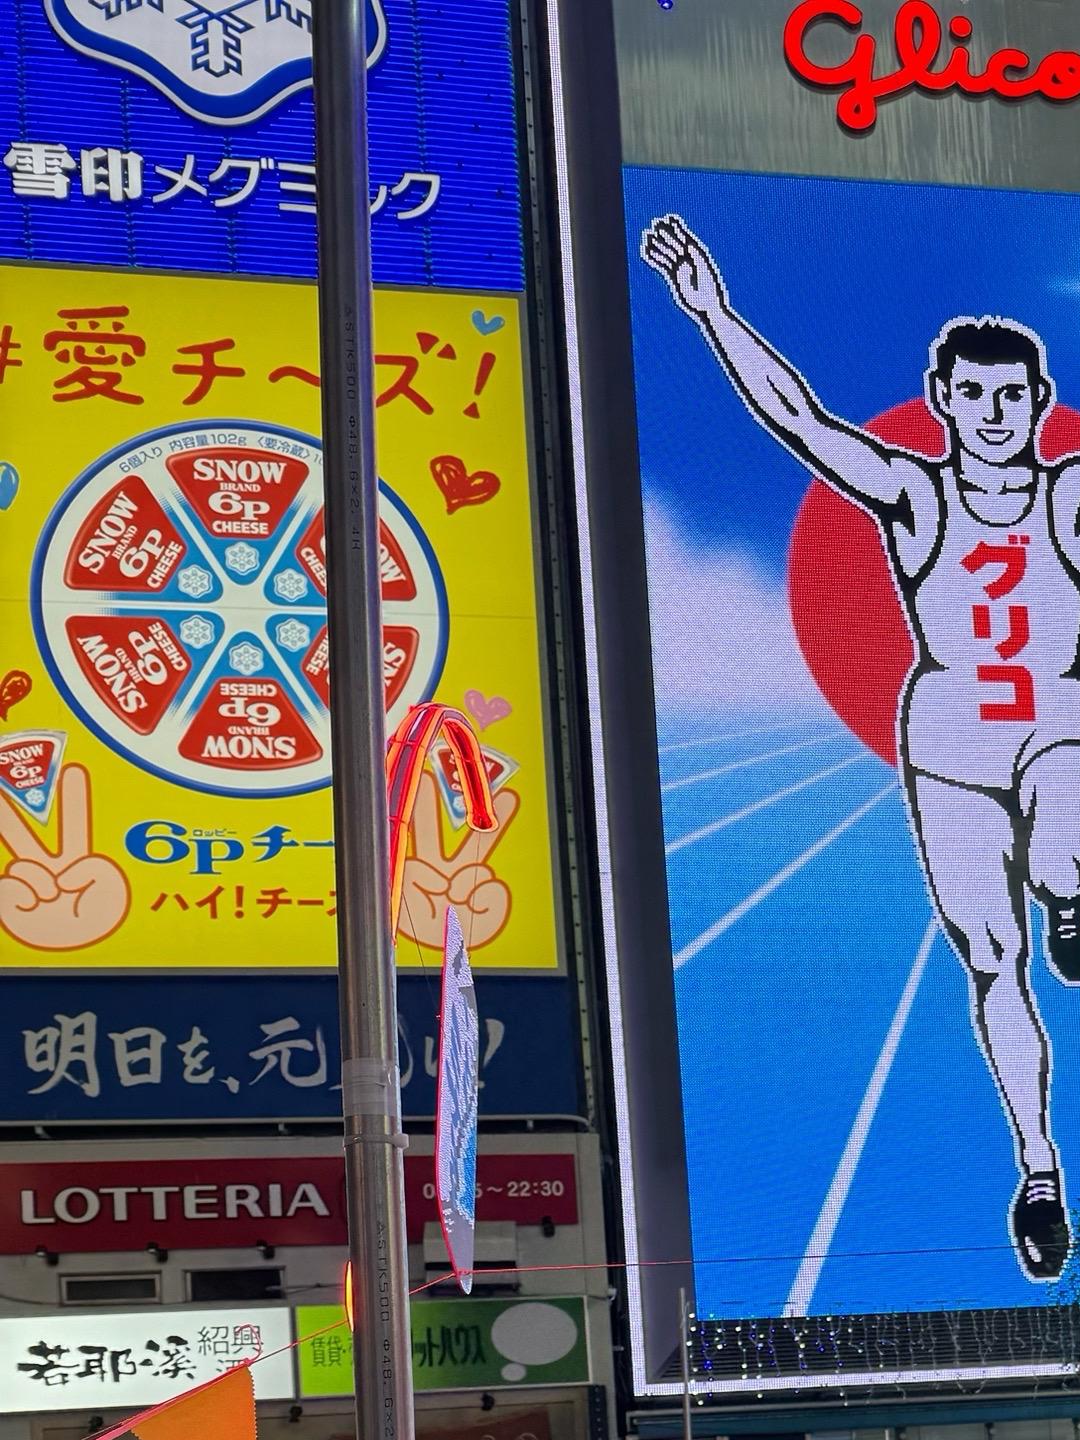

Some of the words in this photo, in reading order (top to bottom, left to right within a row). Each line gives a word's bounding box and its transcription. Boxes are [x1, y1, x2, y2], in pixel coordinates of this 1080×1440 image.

[3, 140, 441, 221] 雪印メグミク
[119, 446, 163, 473] 6個入り
[169, 433, 247, 453] 内容量102g
[192, 458, 287, 484] SNOW
[219, 483, 261, 493] BRAND
[78, 491, 138, 575] SNOW
[111, 525, 138, 560] BRAND
[212, 520, 269, 534] CHEESE
[146, 541, 183, 589] CHEESE
[147, 621, 188, 671] CHEESE
[959, 534, 1036, 721] グリコ
[76, 635, 148, 713] SNOW
[115, 647, 144, 683] BRAND
[220, 683, 277, 697] CHEESE
[200, 735, 296, 760] SNOW
[227, 726, 270, 736] BRAND
[0, 743, 44, 765] SNOW
[21, 1183, 330, 1225] LOTTERIA
[411, 1324, 487, 1368] ットハウス
